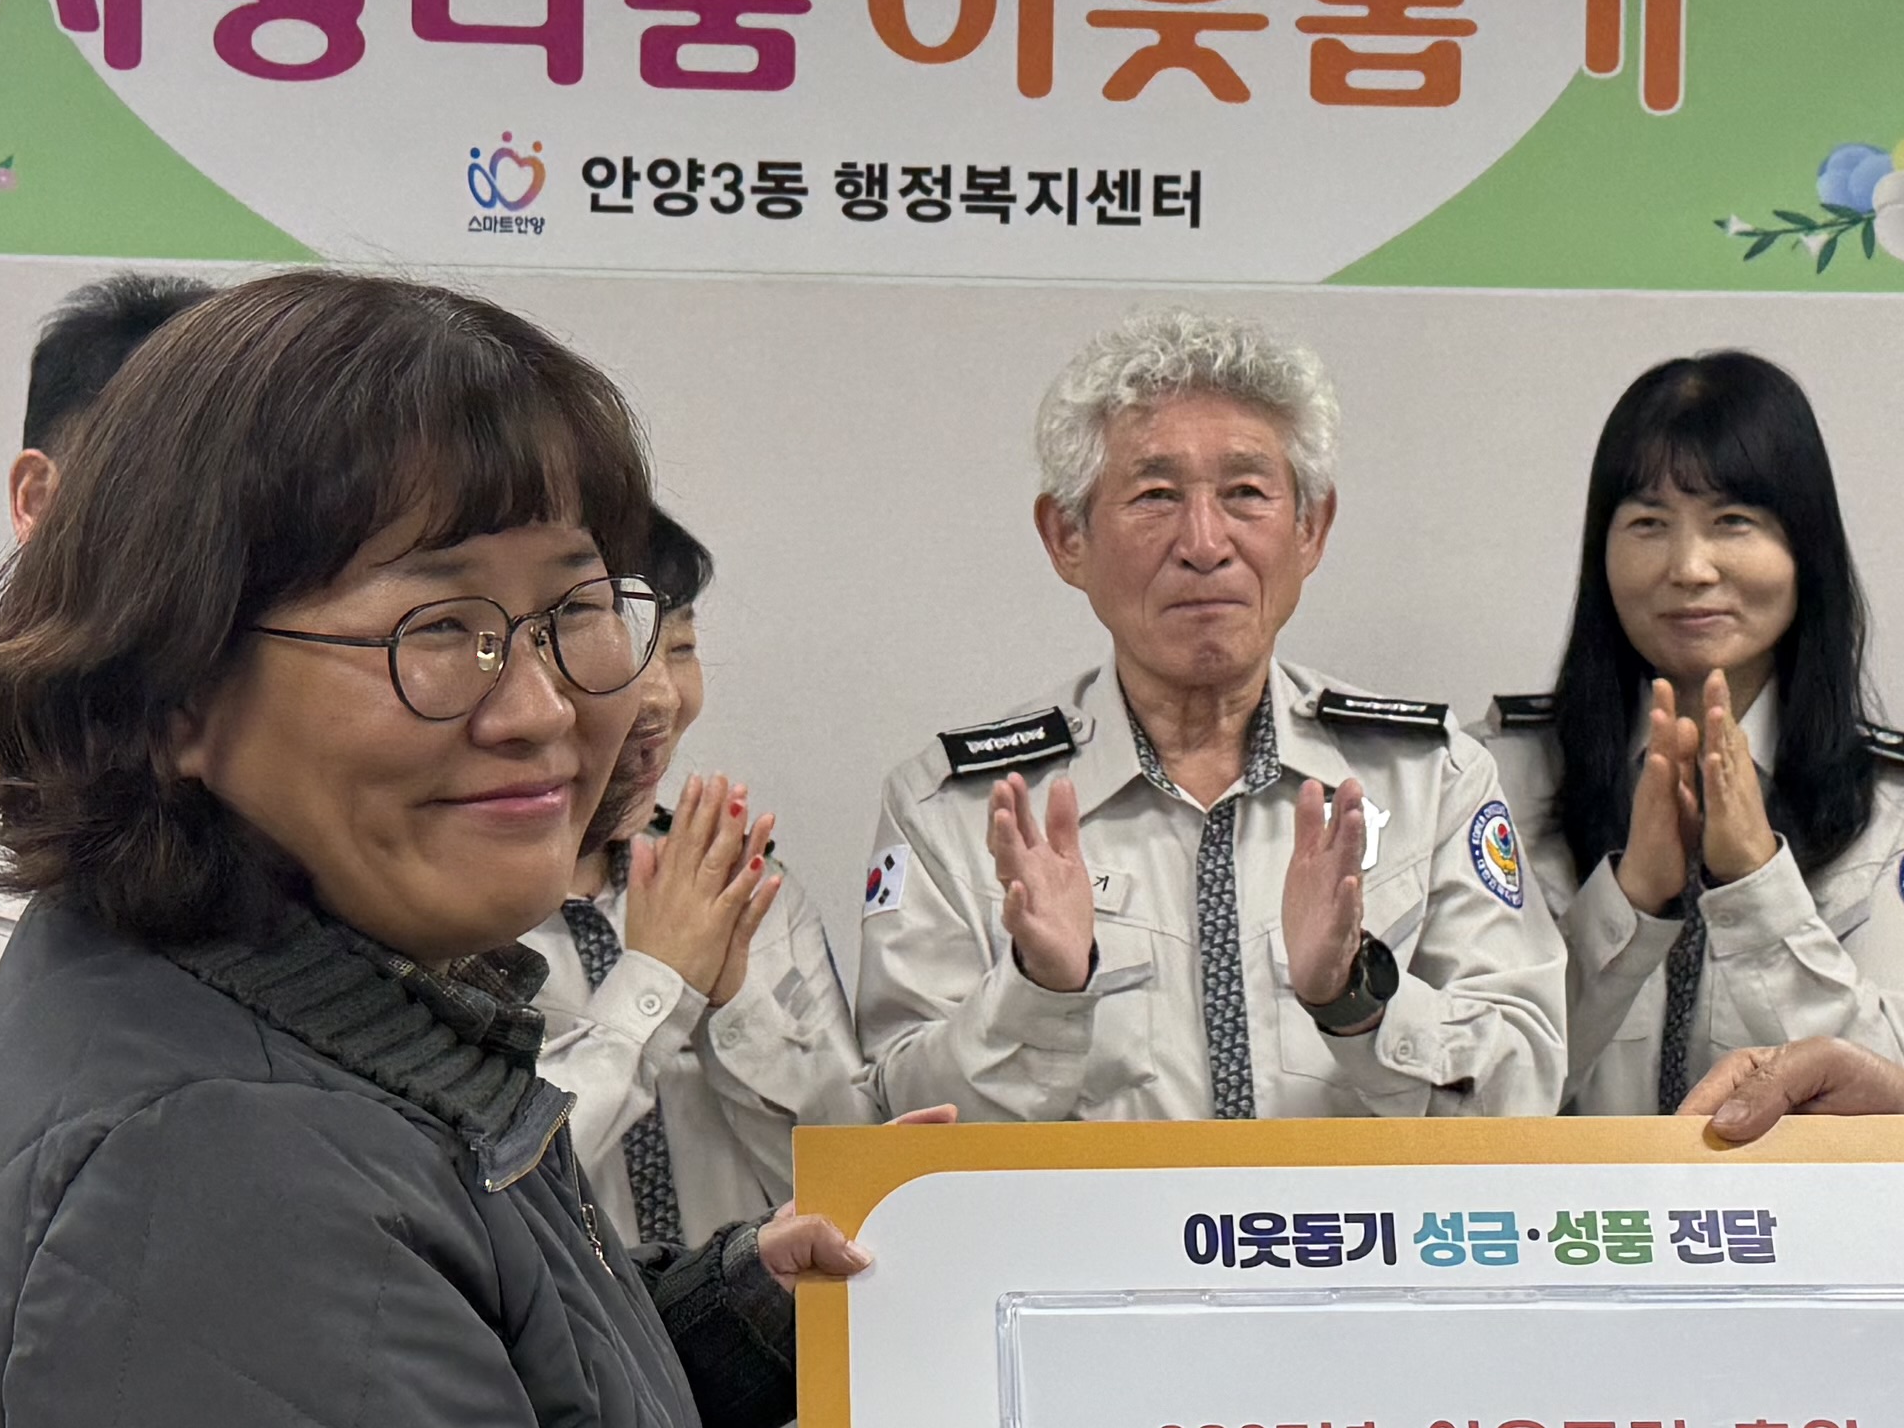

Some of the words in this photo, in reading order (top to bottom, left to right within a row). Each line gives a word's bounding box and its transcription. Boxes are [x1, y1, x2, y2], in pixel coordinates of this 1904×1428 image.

[581, 154, 809, 219] 안양3동
[834, 162, 1203, 230] 행정복지센터
[468, 215, 545, 235] 스마트안양
[1184, 1213, 1397, 1269] 이웃돕기
[1668, 1209, 1777, 1265] 전달
